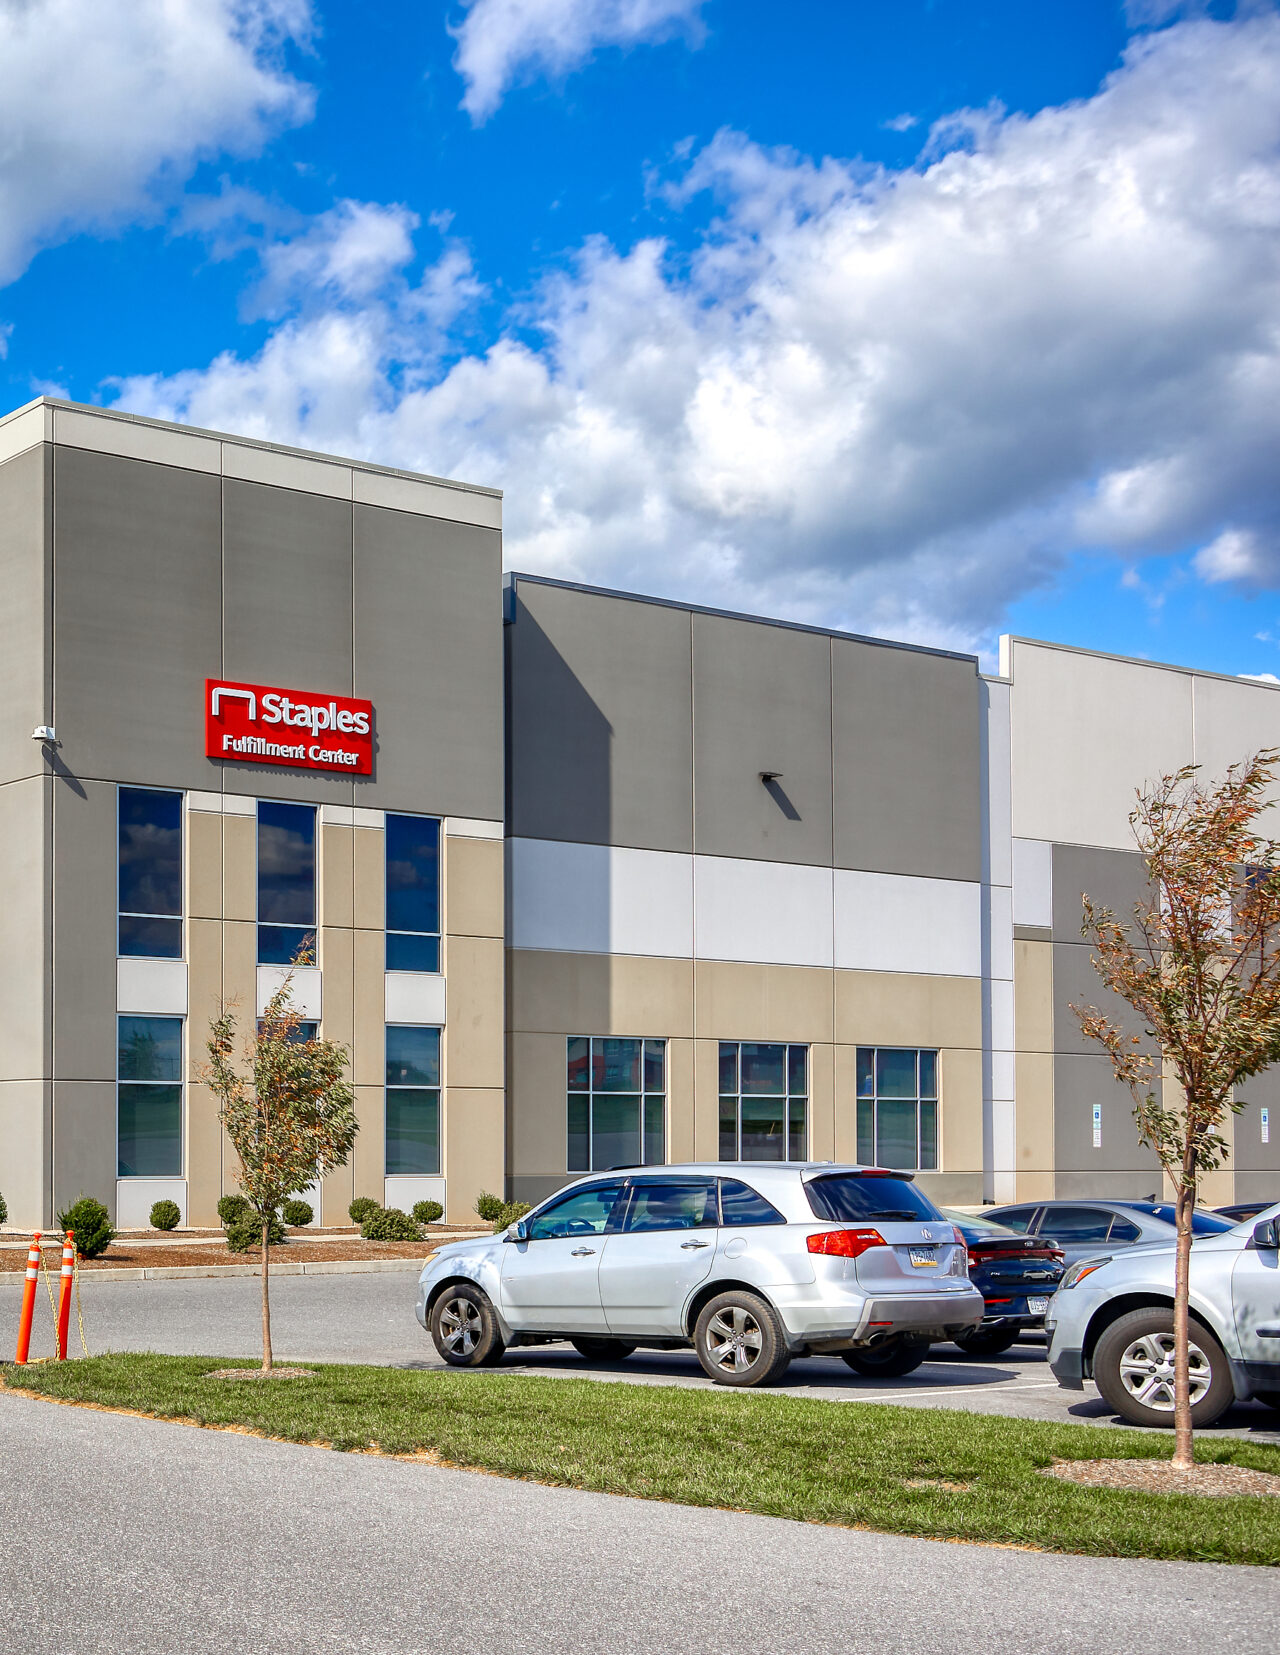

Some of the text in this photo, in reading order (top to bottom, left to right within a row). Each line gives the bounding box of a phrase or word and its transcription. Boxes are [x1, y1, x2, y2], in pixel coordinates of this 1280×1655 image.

[261, 693, 370, 737] Staples
[222, 734, 359, 766] Fulfillment Center
